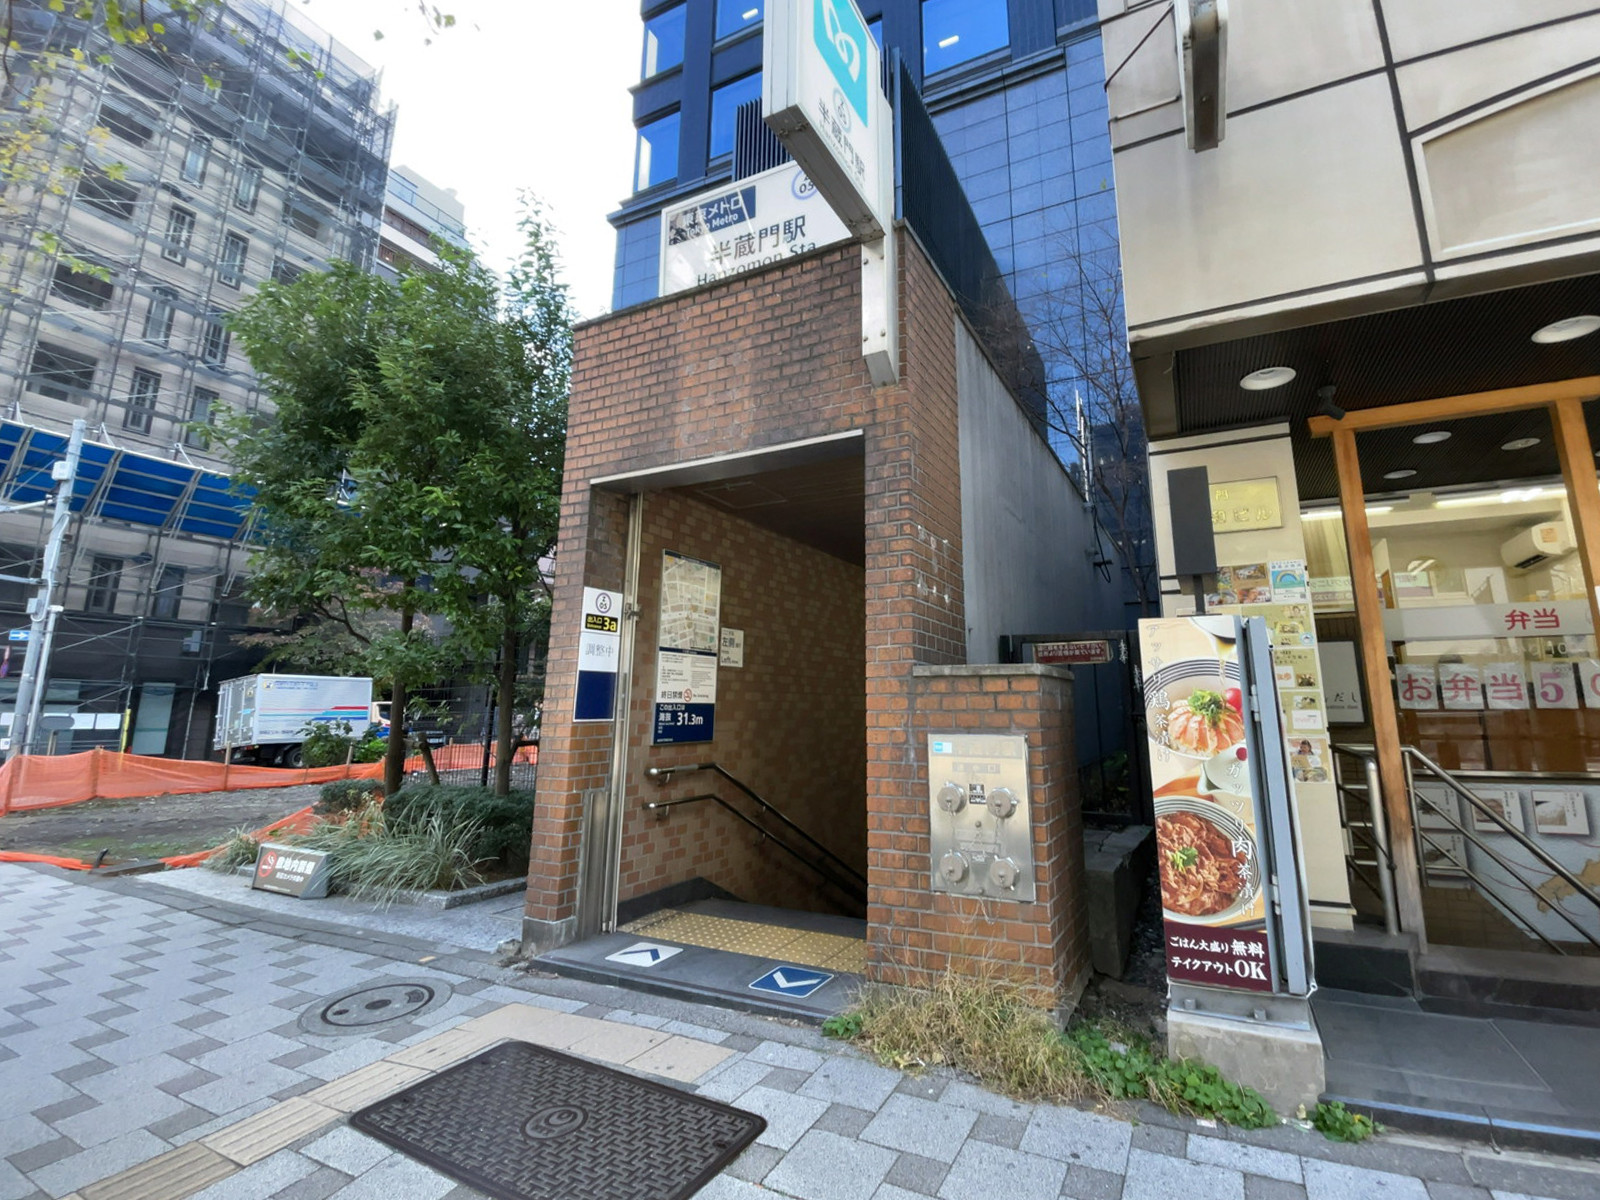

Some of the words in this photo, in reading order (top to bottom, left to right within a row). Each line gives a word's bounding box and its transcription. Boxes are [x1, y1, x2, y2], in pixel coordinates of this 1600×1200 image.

[686, 221, 711, 240] Toko
[712, 213, 739, 228] Metro
[710, 214, 807, 265] 半蔵門駅
[603, 617, 617, 632] 3a
[1504, 607, 1561, 631] 弁当
[676, 712, 704, 726] 31.3m
